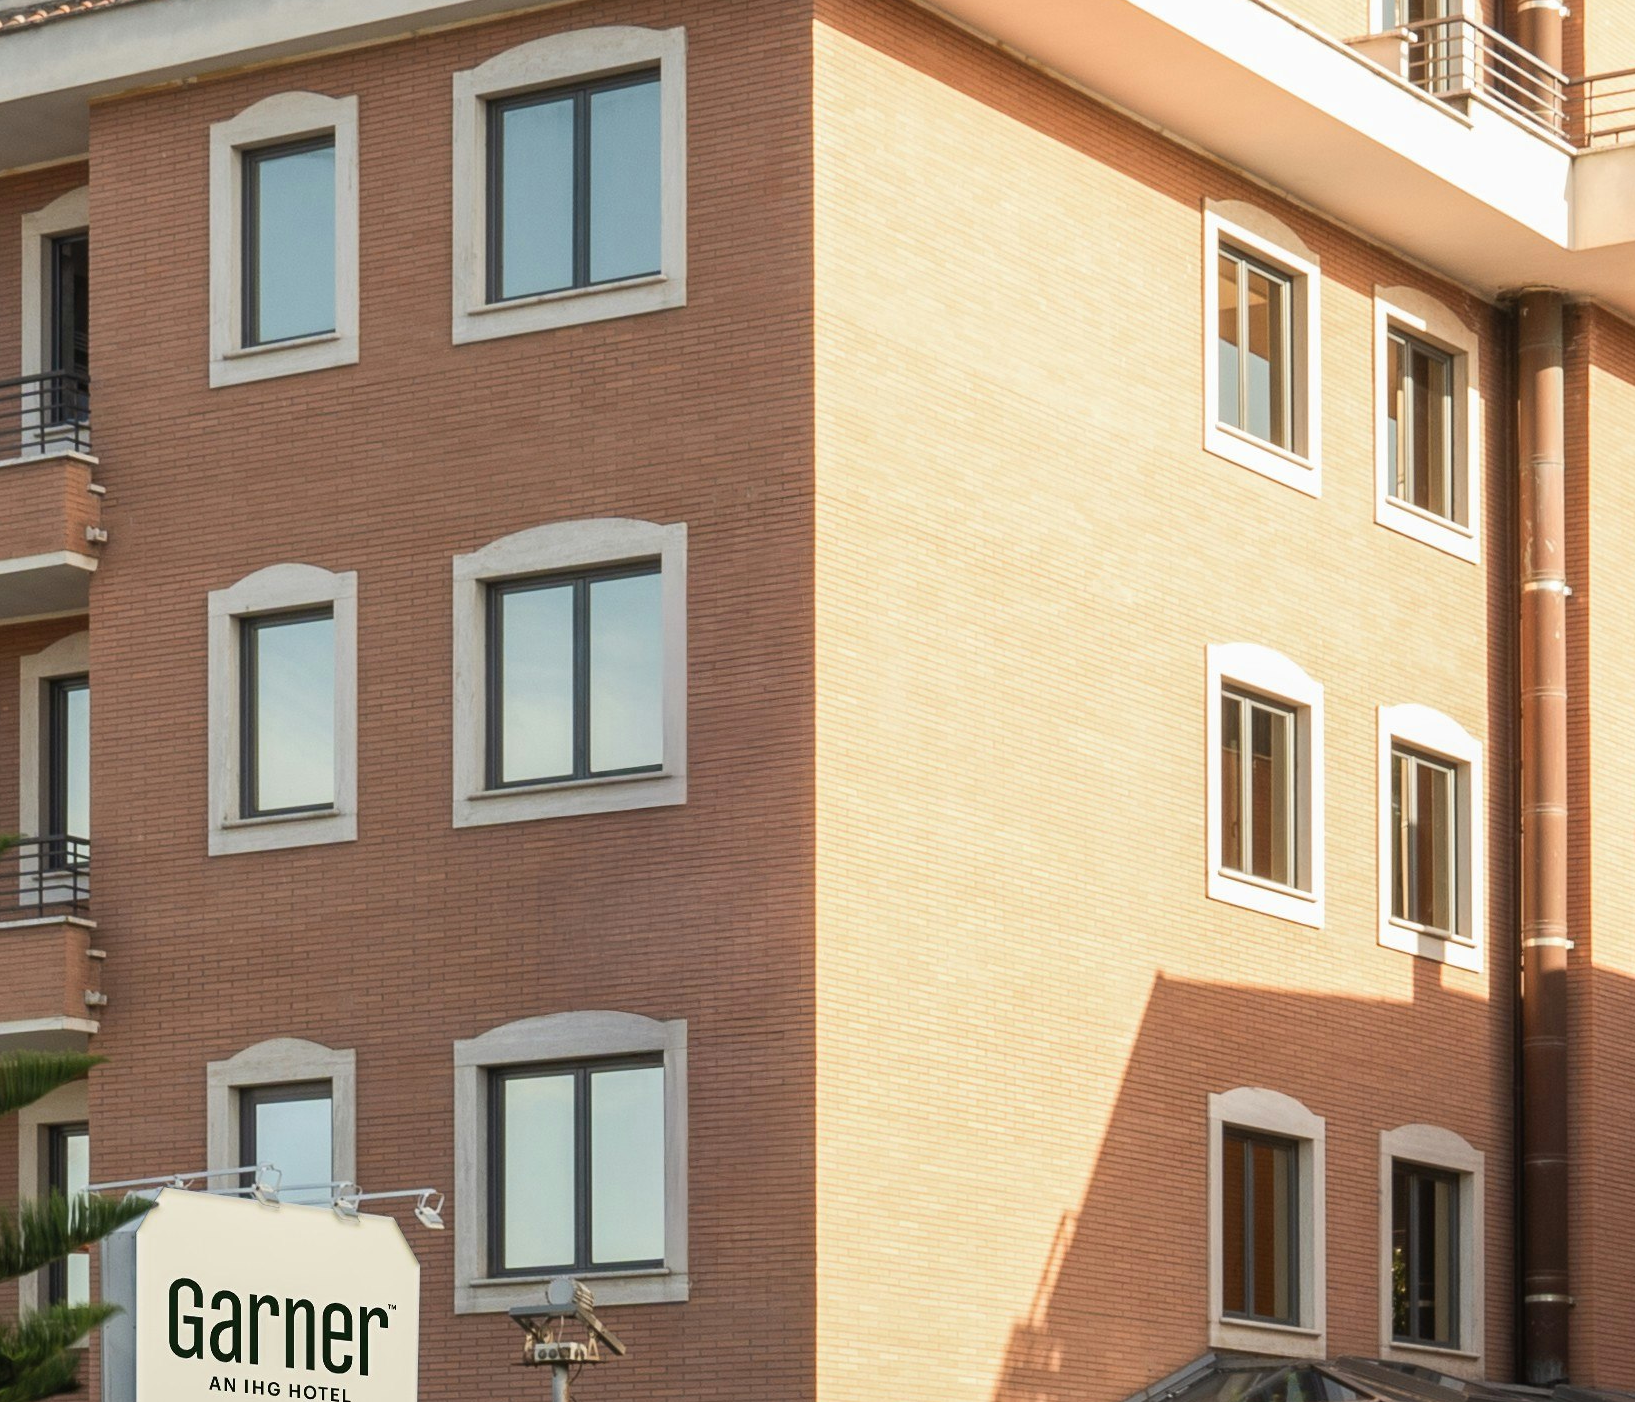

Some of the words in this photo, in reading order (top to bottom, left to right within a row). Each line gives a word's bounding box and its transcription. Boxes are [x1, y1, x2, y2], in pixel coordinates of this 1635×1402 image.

[168, 1277, 390, 1377] Garner
[209, 1375, 237, 1393] AN
[244, 1378, 281, 1397] IHG
